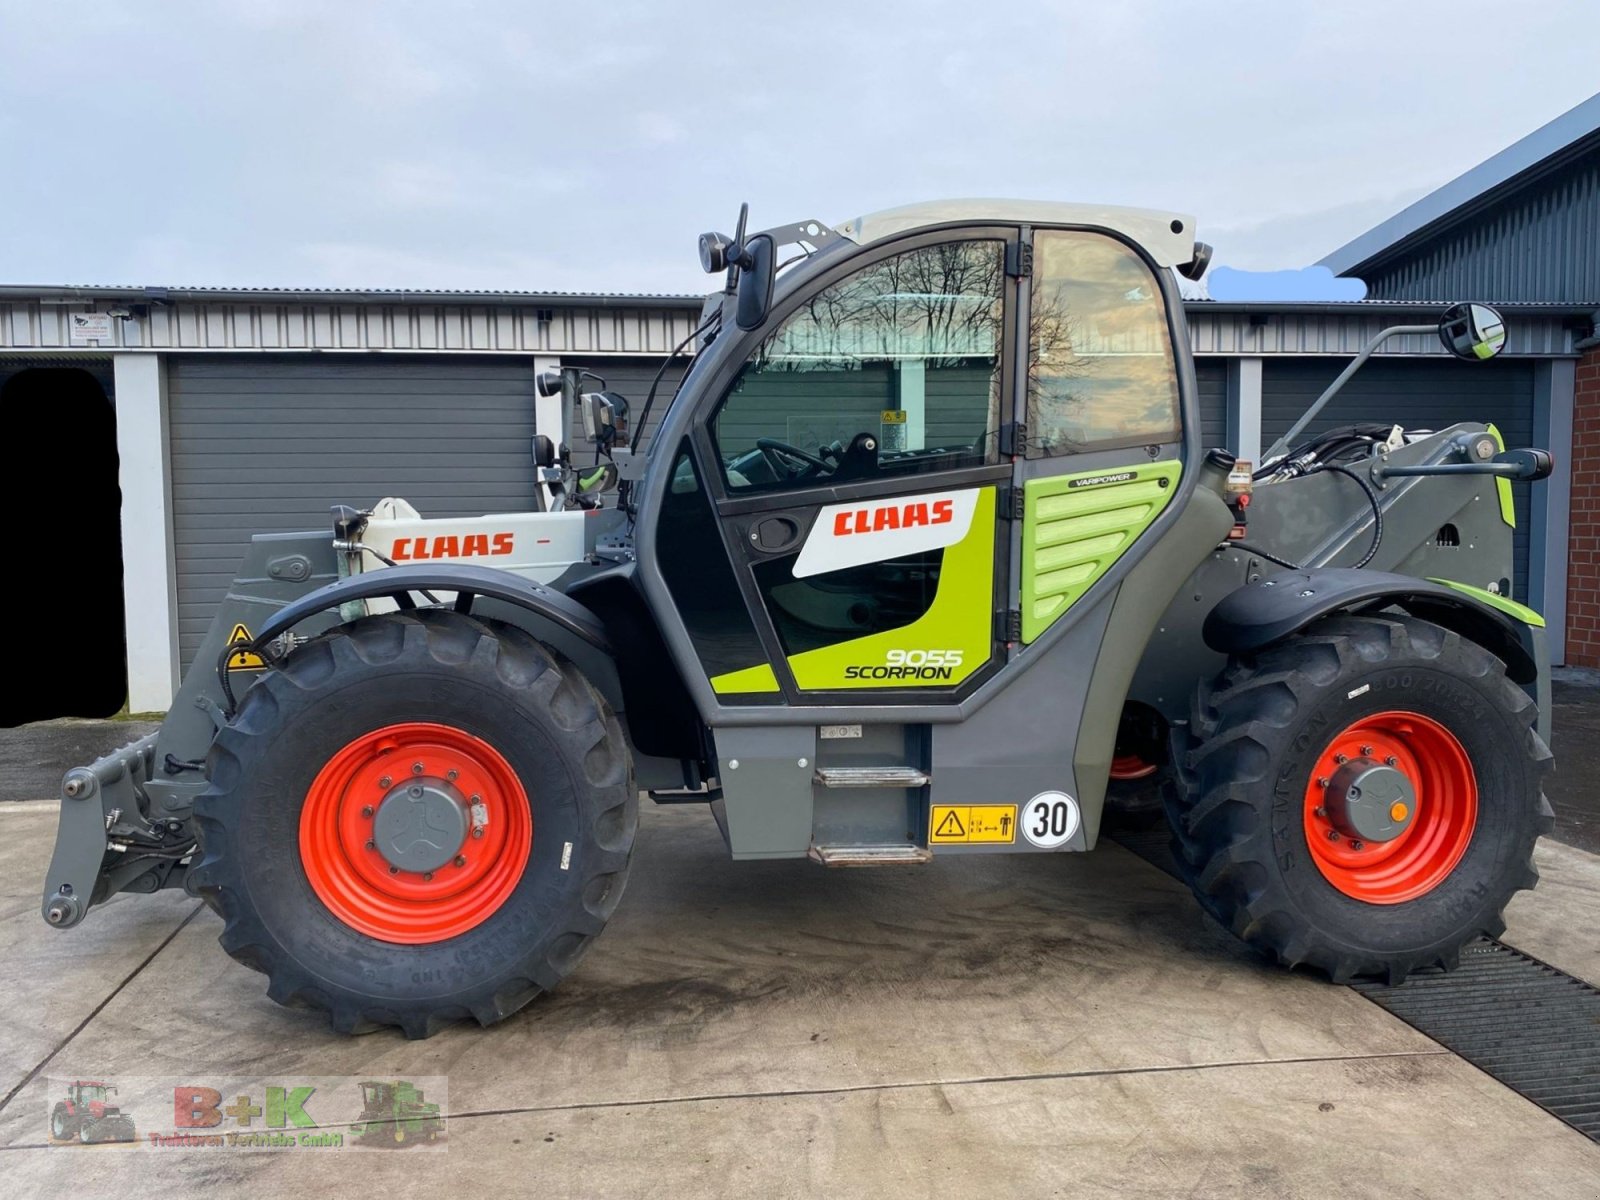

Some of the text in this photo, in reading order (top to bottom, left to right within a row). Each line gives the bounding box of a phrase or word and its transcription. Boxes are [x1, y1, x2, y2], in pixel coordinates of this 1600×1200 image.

[1075, 472, 1131, 487] VARIPOWER
[833, 499, 953, 537] CLAAS
[391, 533, 514, 561] CLAAS
[886, 649, 964, 667] 9055
[844, 666, 952, 680] SCORPION
[1032, 801, 1069, 838] 30
